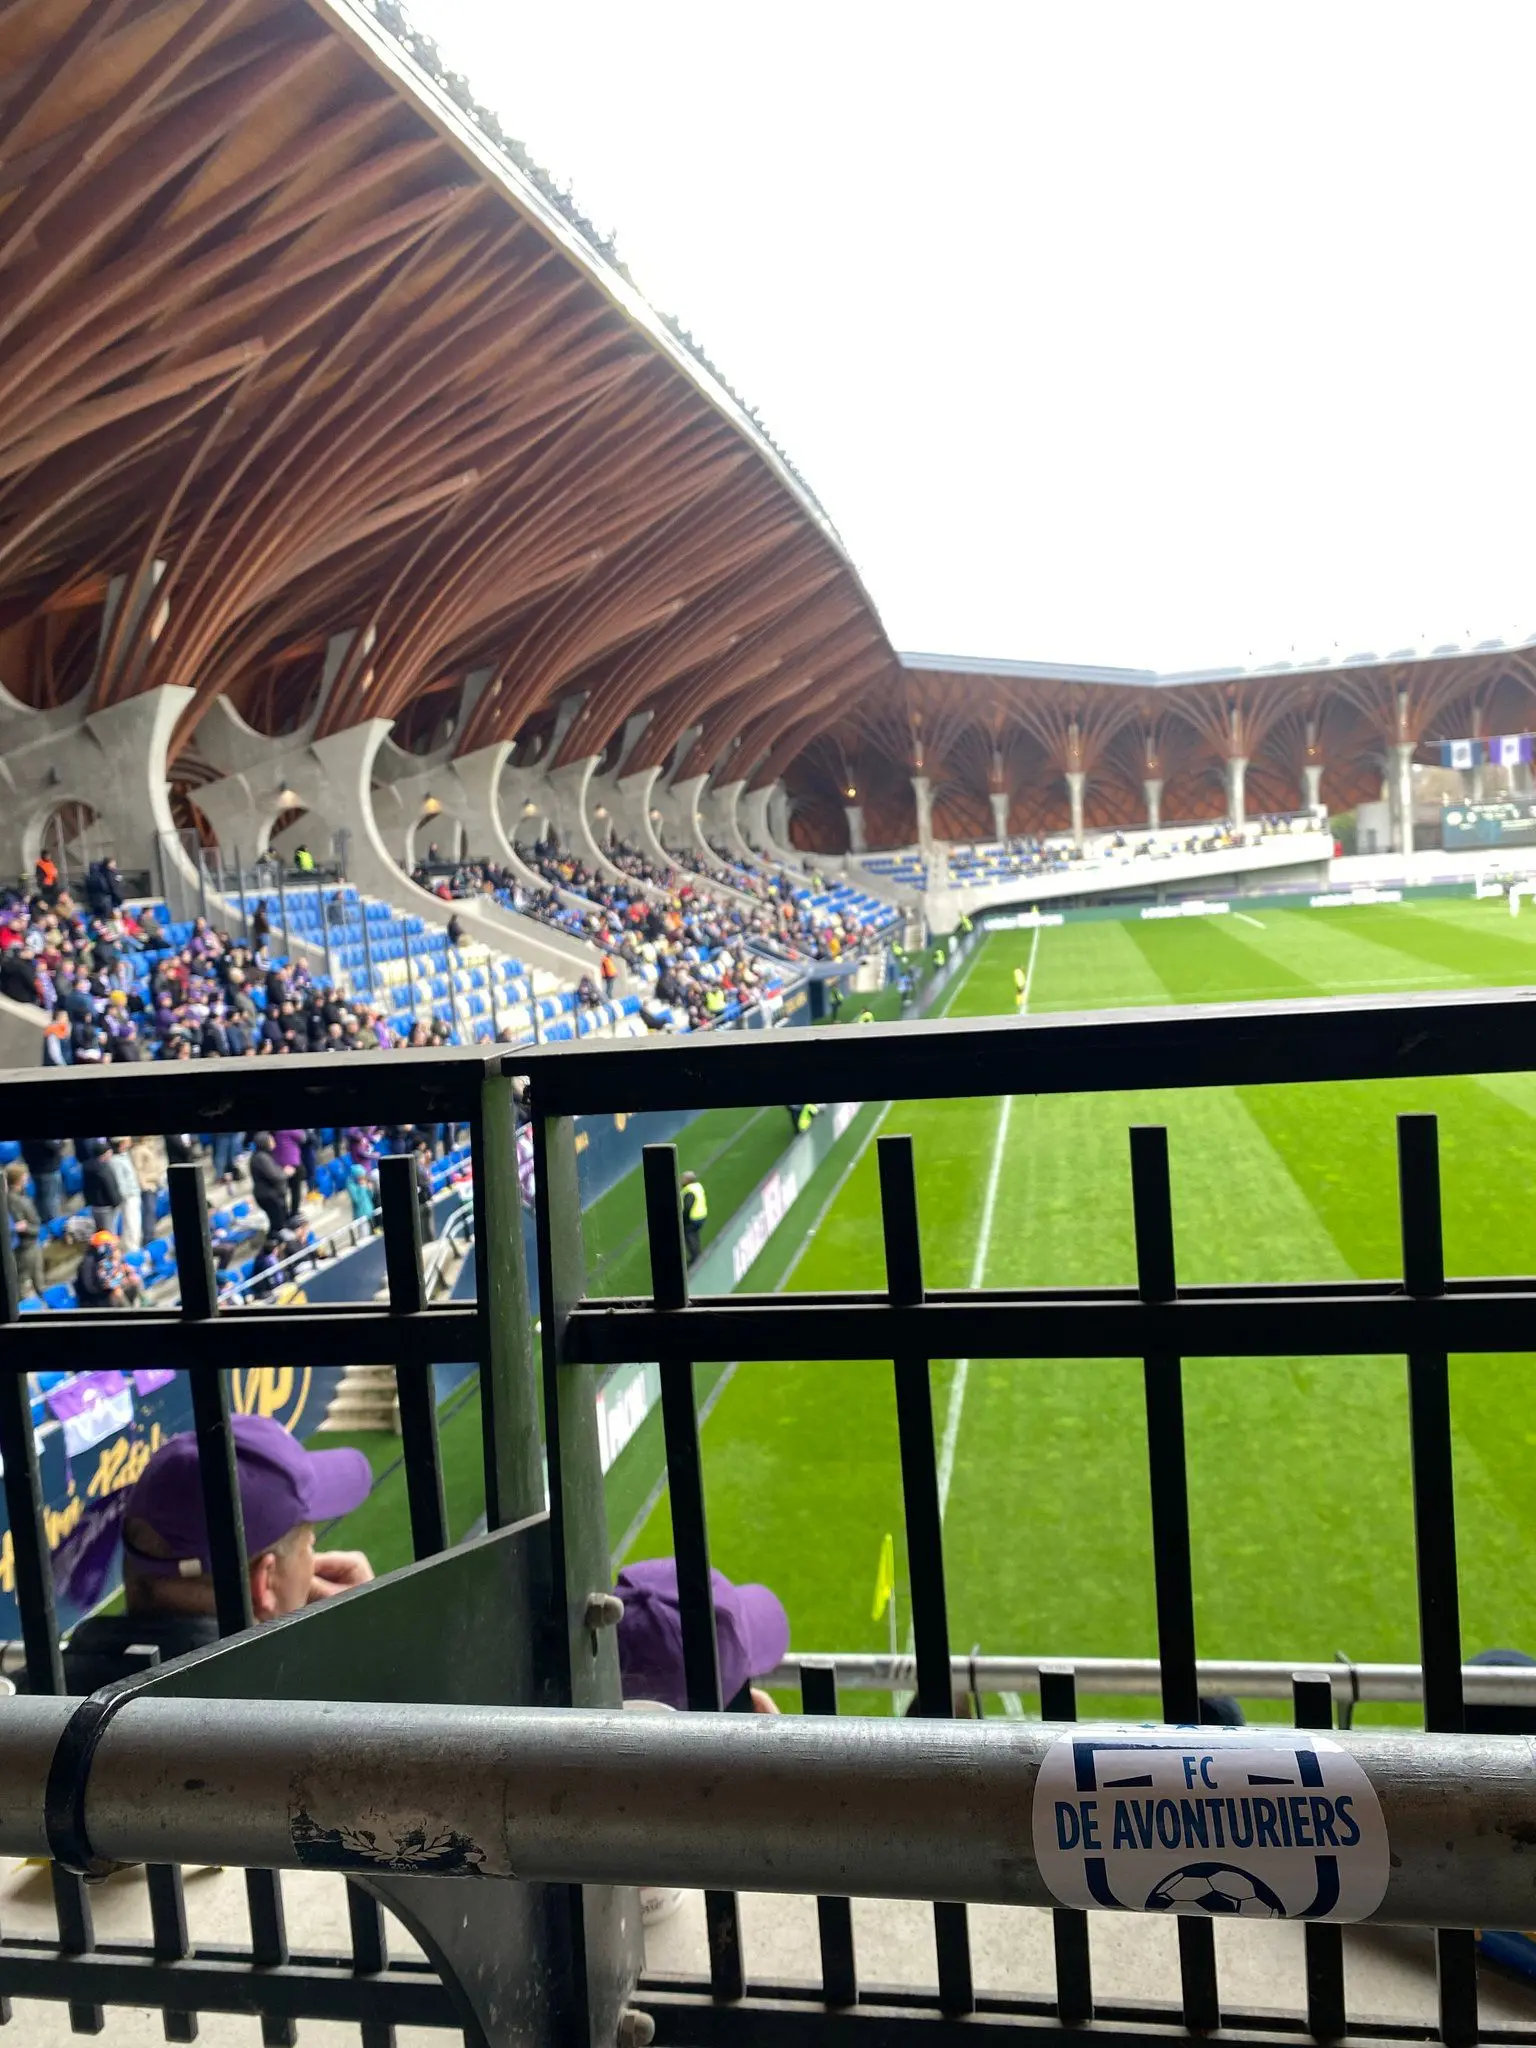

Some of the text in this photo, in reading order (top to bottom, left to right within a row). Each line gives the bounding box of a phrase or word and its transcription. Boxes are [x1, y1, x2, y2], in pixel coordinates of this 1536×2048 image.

[1182, 1756, 1218, 1790] FC
[1054, 1796, 1361, 1850] DE AVONTURIERS
